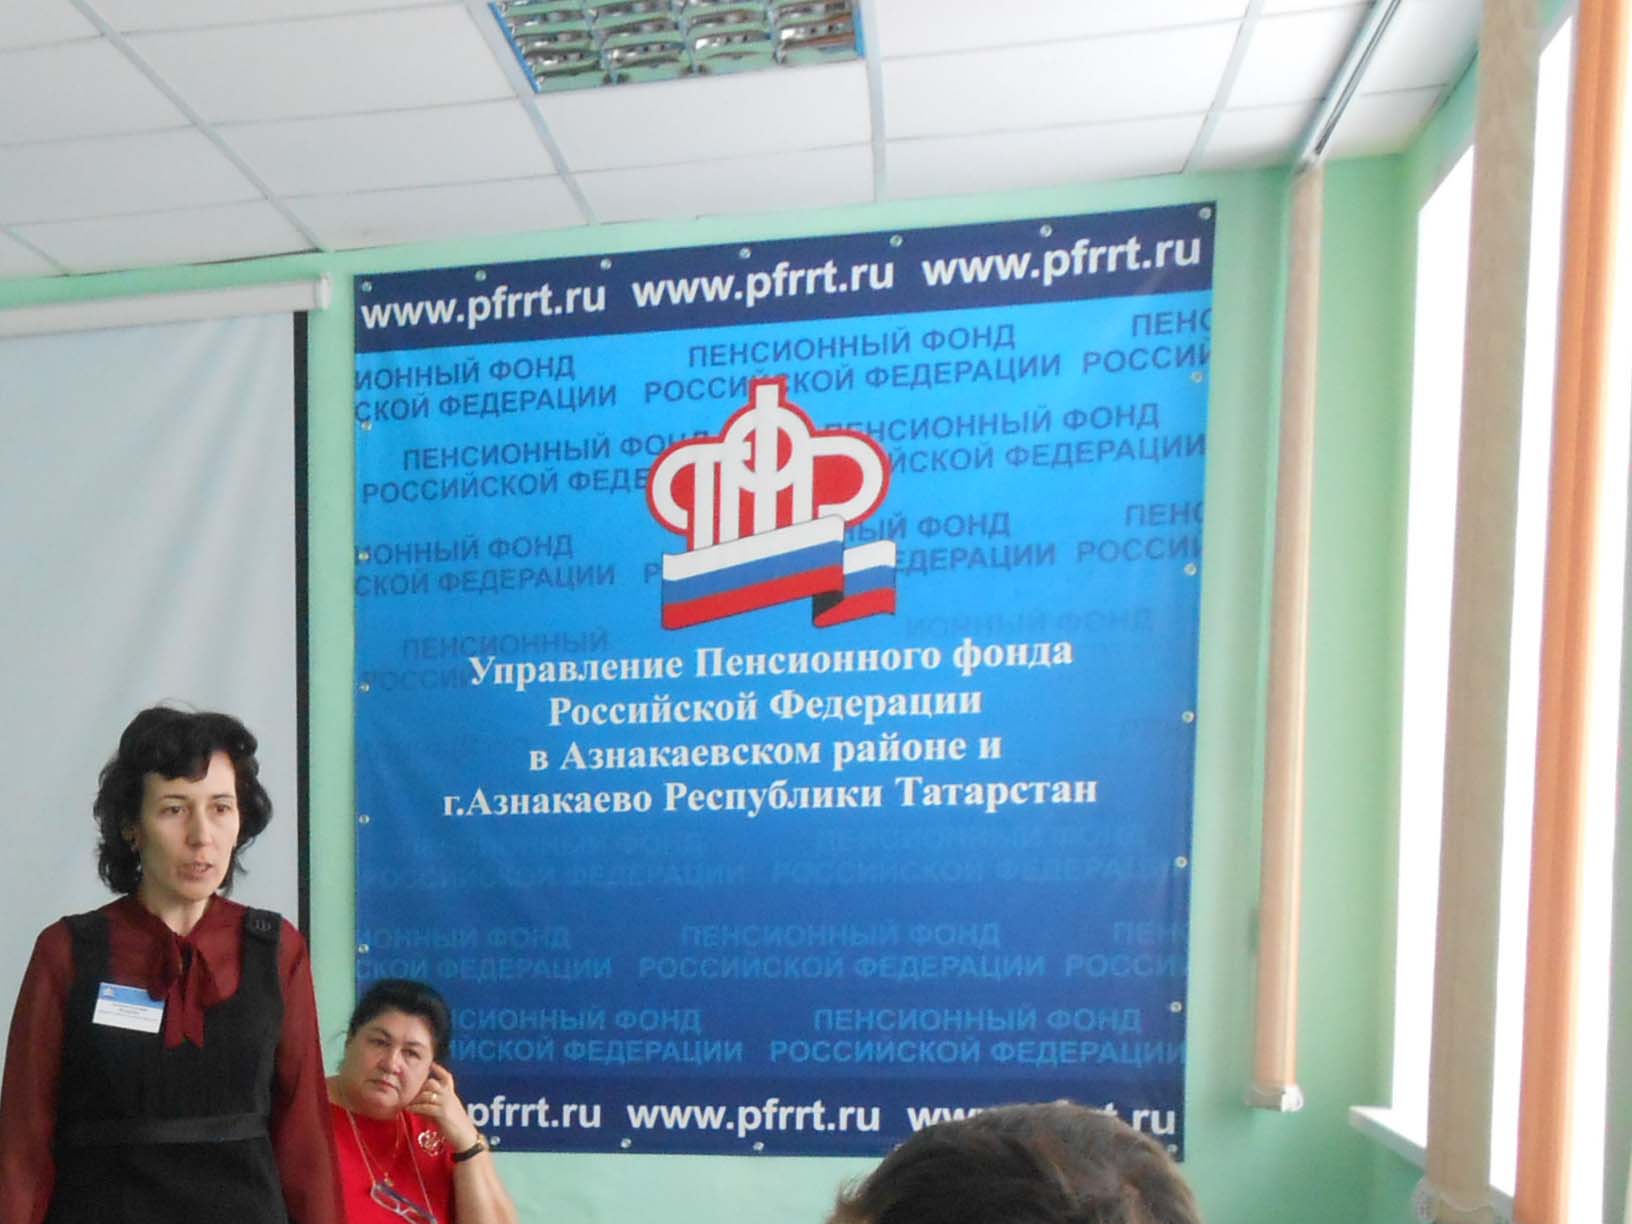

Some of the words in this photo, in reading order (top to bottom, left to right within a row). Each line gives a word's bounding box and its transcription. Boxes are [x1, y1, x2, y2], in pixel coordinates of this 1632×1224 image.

[361, 284, 607, 330] www.pfrrt.ru
[632, 261, 895, 308] www.pfrrt.ru
[922, 235, 1201, 287] www.pfrrt.ru
[489, 354, 576, 382] ФОНД
[689, 326, 911, 368] ПЕНСИОННЫЙ
[922, 323, 1017, 353] ФОНД
[439, 385, 617, 419] ФЕДЕРАЦИИ
[865, 353, 1062, 390] ФЕДЕРАЦИИ
[403, 432, 610, 472] ПЕНСИОННЫЙ
[1063, 402, 1160, 431] ФОНД
[362, 470, 558, 505] РОССИЙСКОЙ
[489, 533, 575, 561] ФОНД
[917, 511, 1011, 541] ФОНД
[438, 562, 615, 596] ФЕДЕРАЦИИ
[468, 654, 684, 692] Управление
[695, 645, 941, 679] Пенсионного
[952, 637, 1074, 677] фонда
[549, 692, 758, 727] Российской
[769, 688, 983, 725] Федерации
[529, 750, 549, 772] в
[560, 740, 821, 771] Азнакаевском
[834, 732, 968, 771] районе
[977, 736, 1003, 760] и
[443, 787, 653, 818] г.Азнакаево
[664, 779, 883, 819] Республики
[895, 776, 1098, 813] Татарстан
[681, 919, 899, 949] ПЕНСИОННЫЙ
[909, 921, 1002, 949] ФОНД
[436, 956, 613, 985] ФЕДЕРАЦИИ
[639, 950, 844, 980] РОССИЙСКОЙ
[853, 954, 1046, 983] ФЕДЕРАЦИИ
[614, 1007, 702, 1035] ФОНД
[814, 1003, 1037, 1032] ПЕНСИОННЫЙ
[1046, 1007, 1143, 1035] ФОНД
[563, 1039, 743, 1067] ФЕДЕРАЦИИ
[769, 1036, 980, 1064] РОССИЙСКОЙ
[626, 1098, 880, 1138] www.pfrrt.ru
